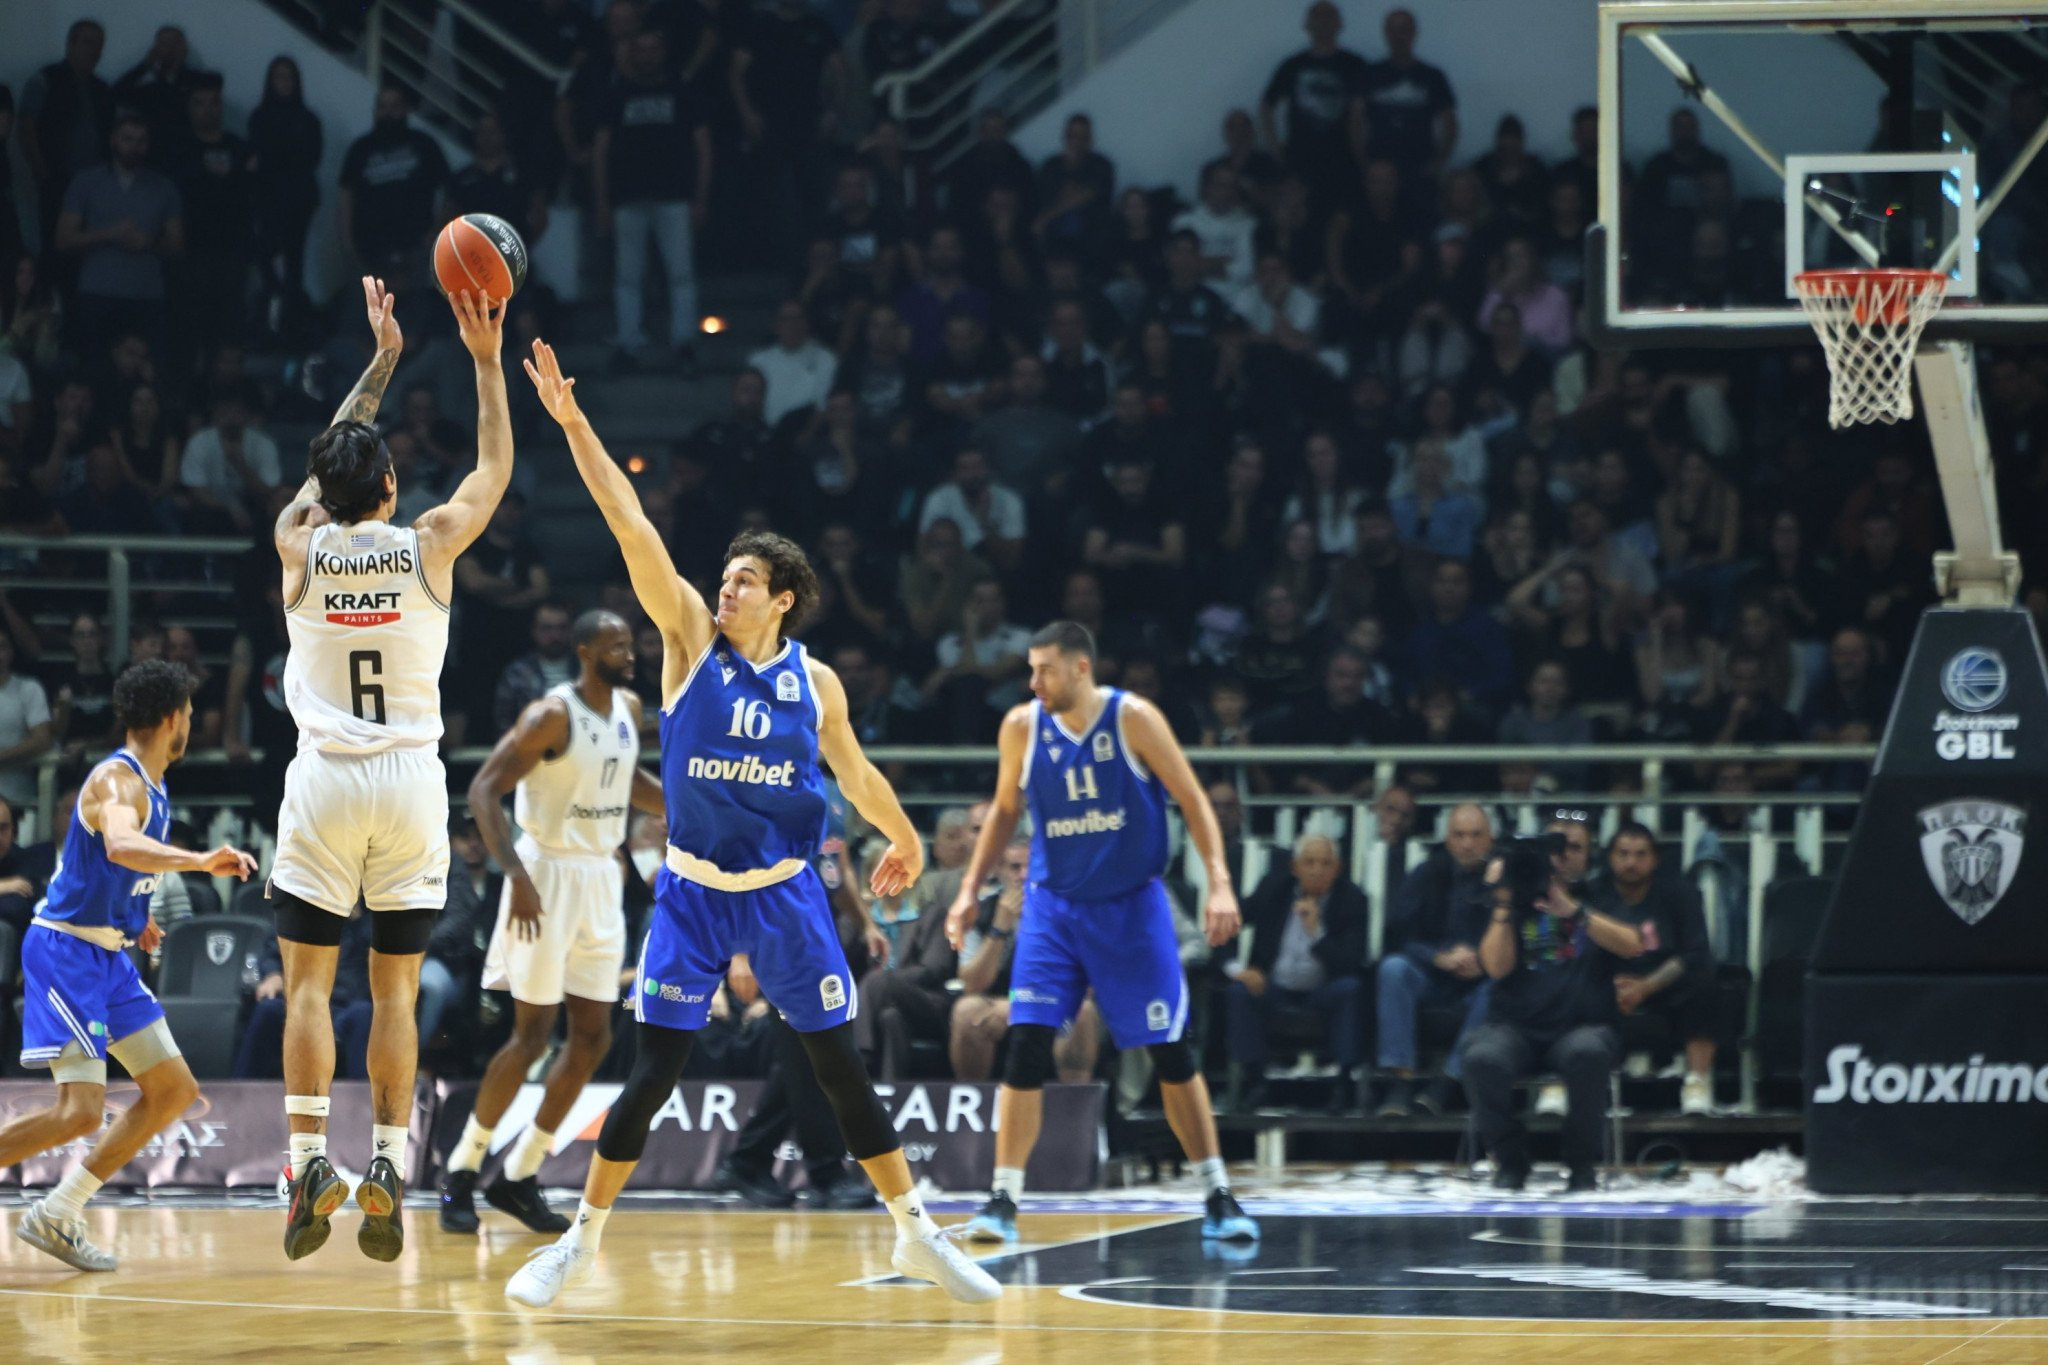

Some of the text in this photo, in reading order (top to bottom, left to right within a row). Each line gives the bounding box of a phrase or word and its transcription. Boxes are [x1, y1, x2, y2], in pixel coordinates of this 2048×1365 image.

[315, 549, 412, 575] KONIARIS
[325, 593, 401, 610] KRAFT
[344, 615, 382, 623] PAINTS
[349, 650, 386, 726] 6
[726, 697, 771, 739] 16
[1935, 732, 2015, 760] GBL
[600, 757, 618, 789] 17
[687, 754, 795, 787] novibet
[1065, 765, 1099, 801] 14
[660, 983, 682, 995] eco
